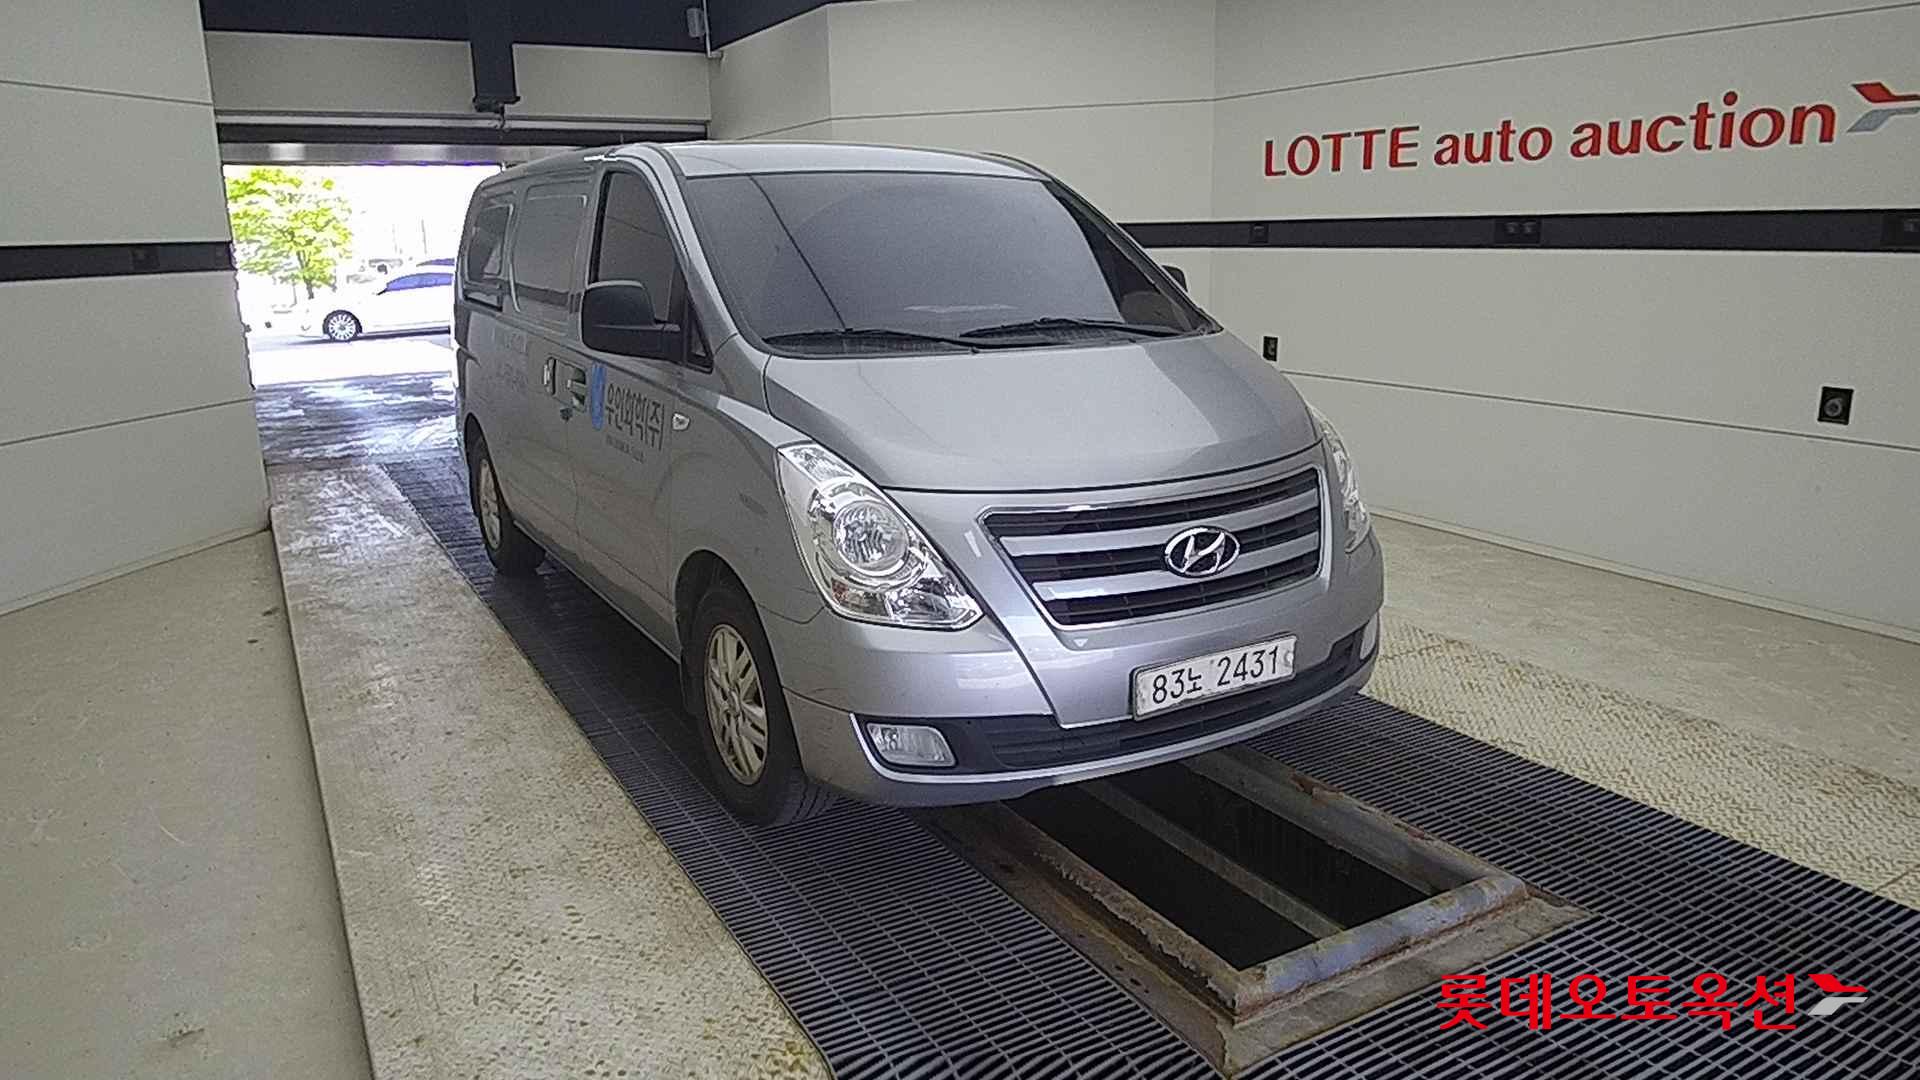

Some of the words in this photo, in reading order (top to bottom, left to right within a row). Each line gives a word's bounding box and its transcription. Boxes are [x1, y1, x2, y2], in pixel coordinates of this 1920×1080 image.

[1264, 125, 1420, 177] LOTTE
[1433, 119, 1553, 166] auto
[1569, 90, 1837, 158] auction
[1152, 667, 1203, 704] 83노
[1216, 645, 1280, 687] 2431
